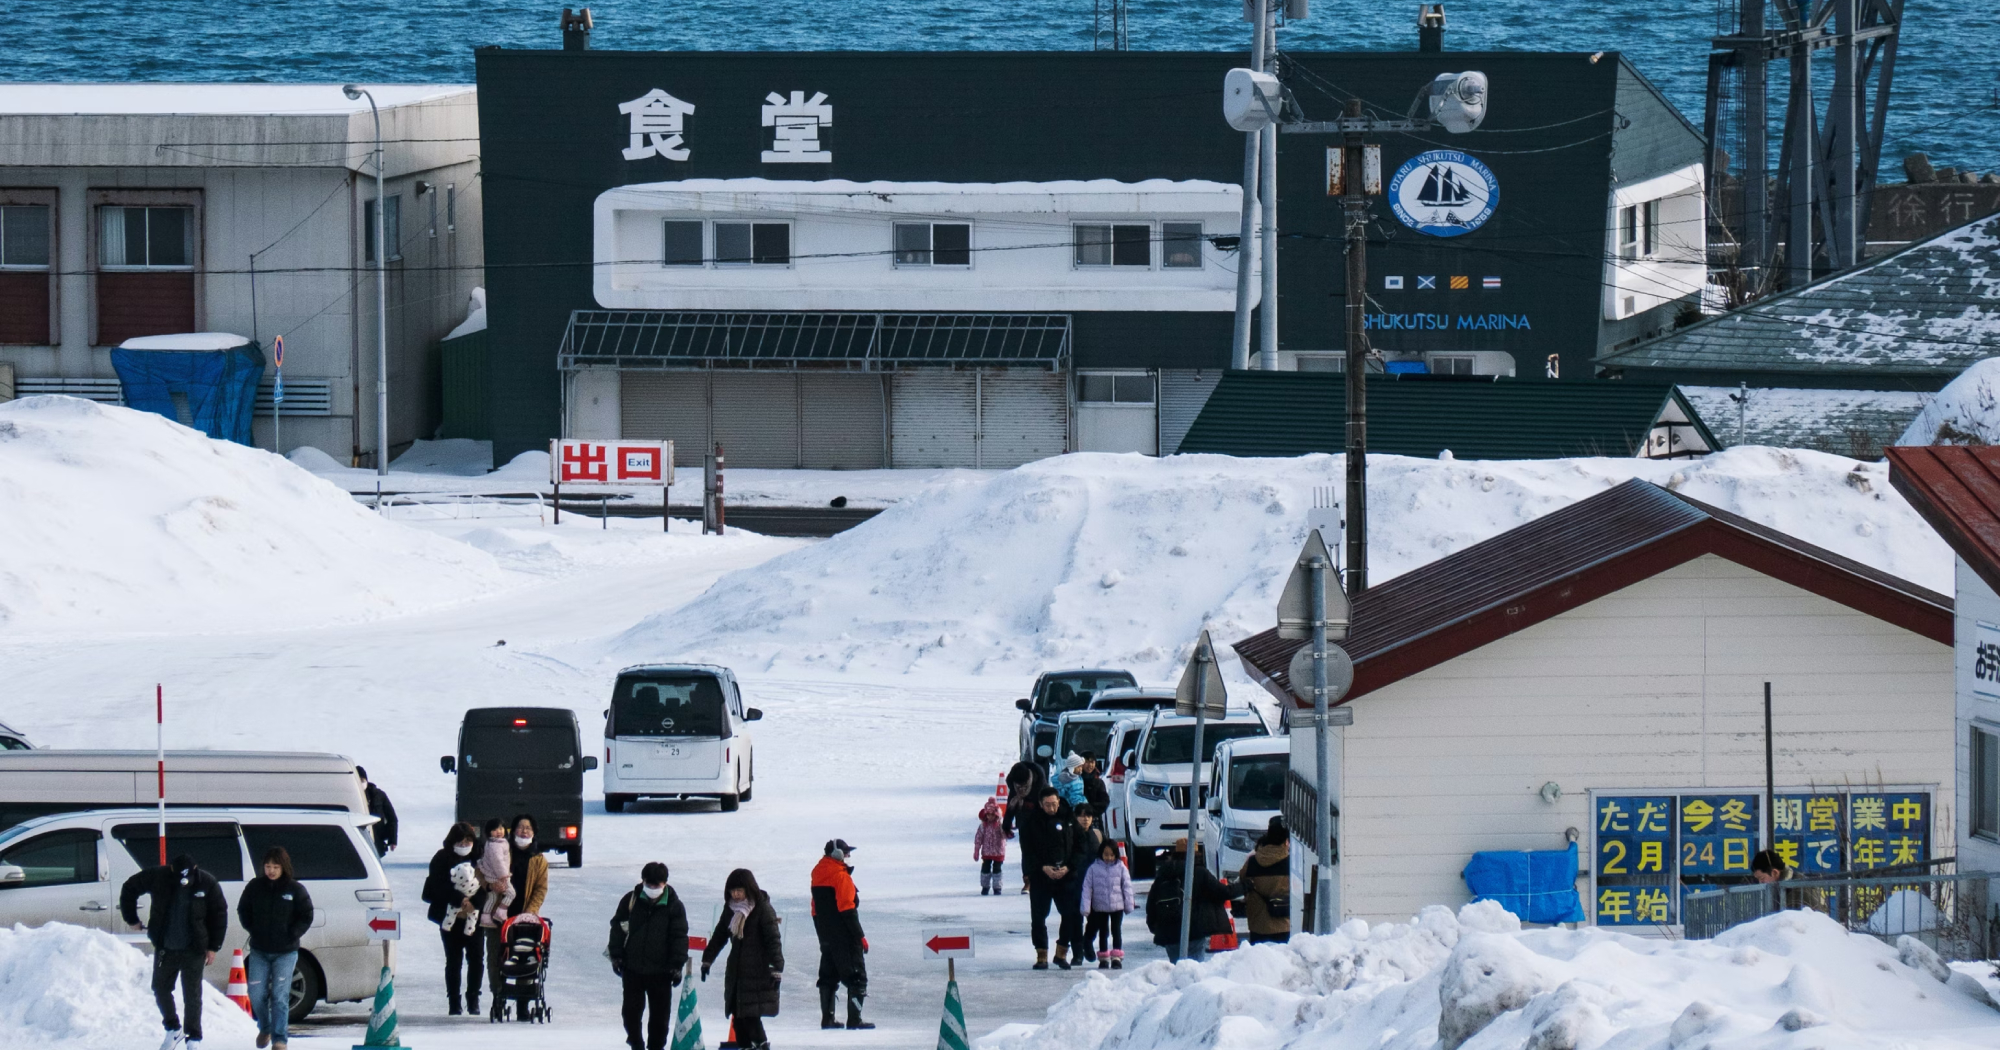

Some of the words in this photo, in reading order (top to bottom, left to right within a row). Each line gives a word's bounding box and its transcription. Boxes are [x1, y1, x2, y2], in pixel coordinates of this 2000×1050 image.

[618, 88, 832, 163] 食堂
[1390, 162, 1413, 192] OTARU
[1418, 152, 1465, 165] SHUKUTSU
[1470, 159, 1497, 191] MARINA
[1393, 203, 1415, 228] SINCE
[1887, 190, 2000, 228] 徐行
[1456, 314, 1531, 330] MARINA
[562, 443, 661, 482] 出口
[628, 458, 650, 467] Exit
[1975, 640, 2000, 684] お手
[1600, 797, 1921, 833] ただ今冬期営業中
